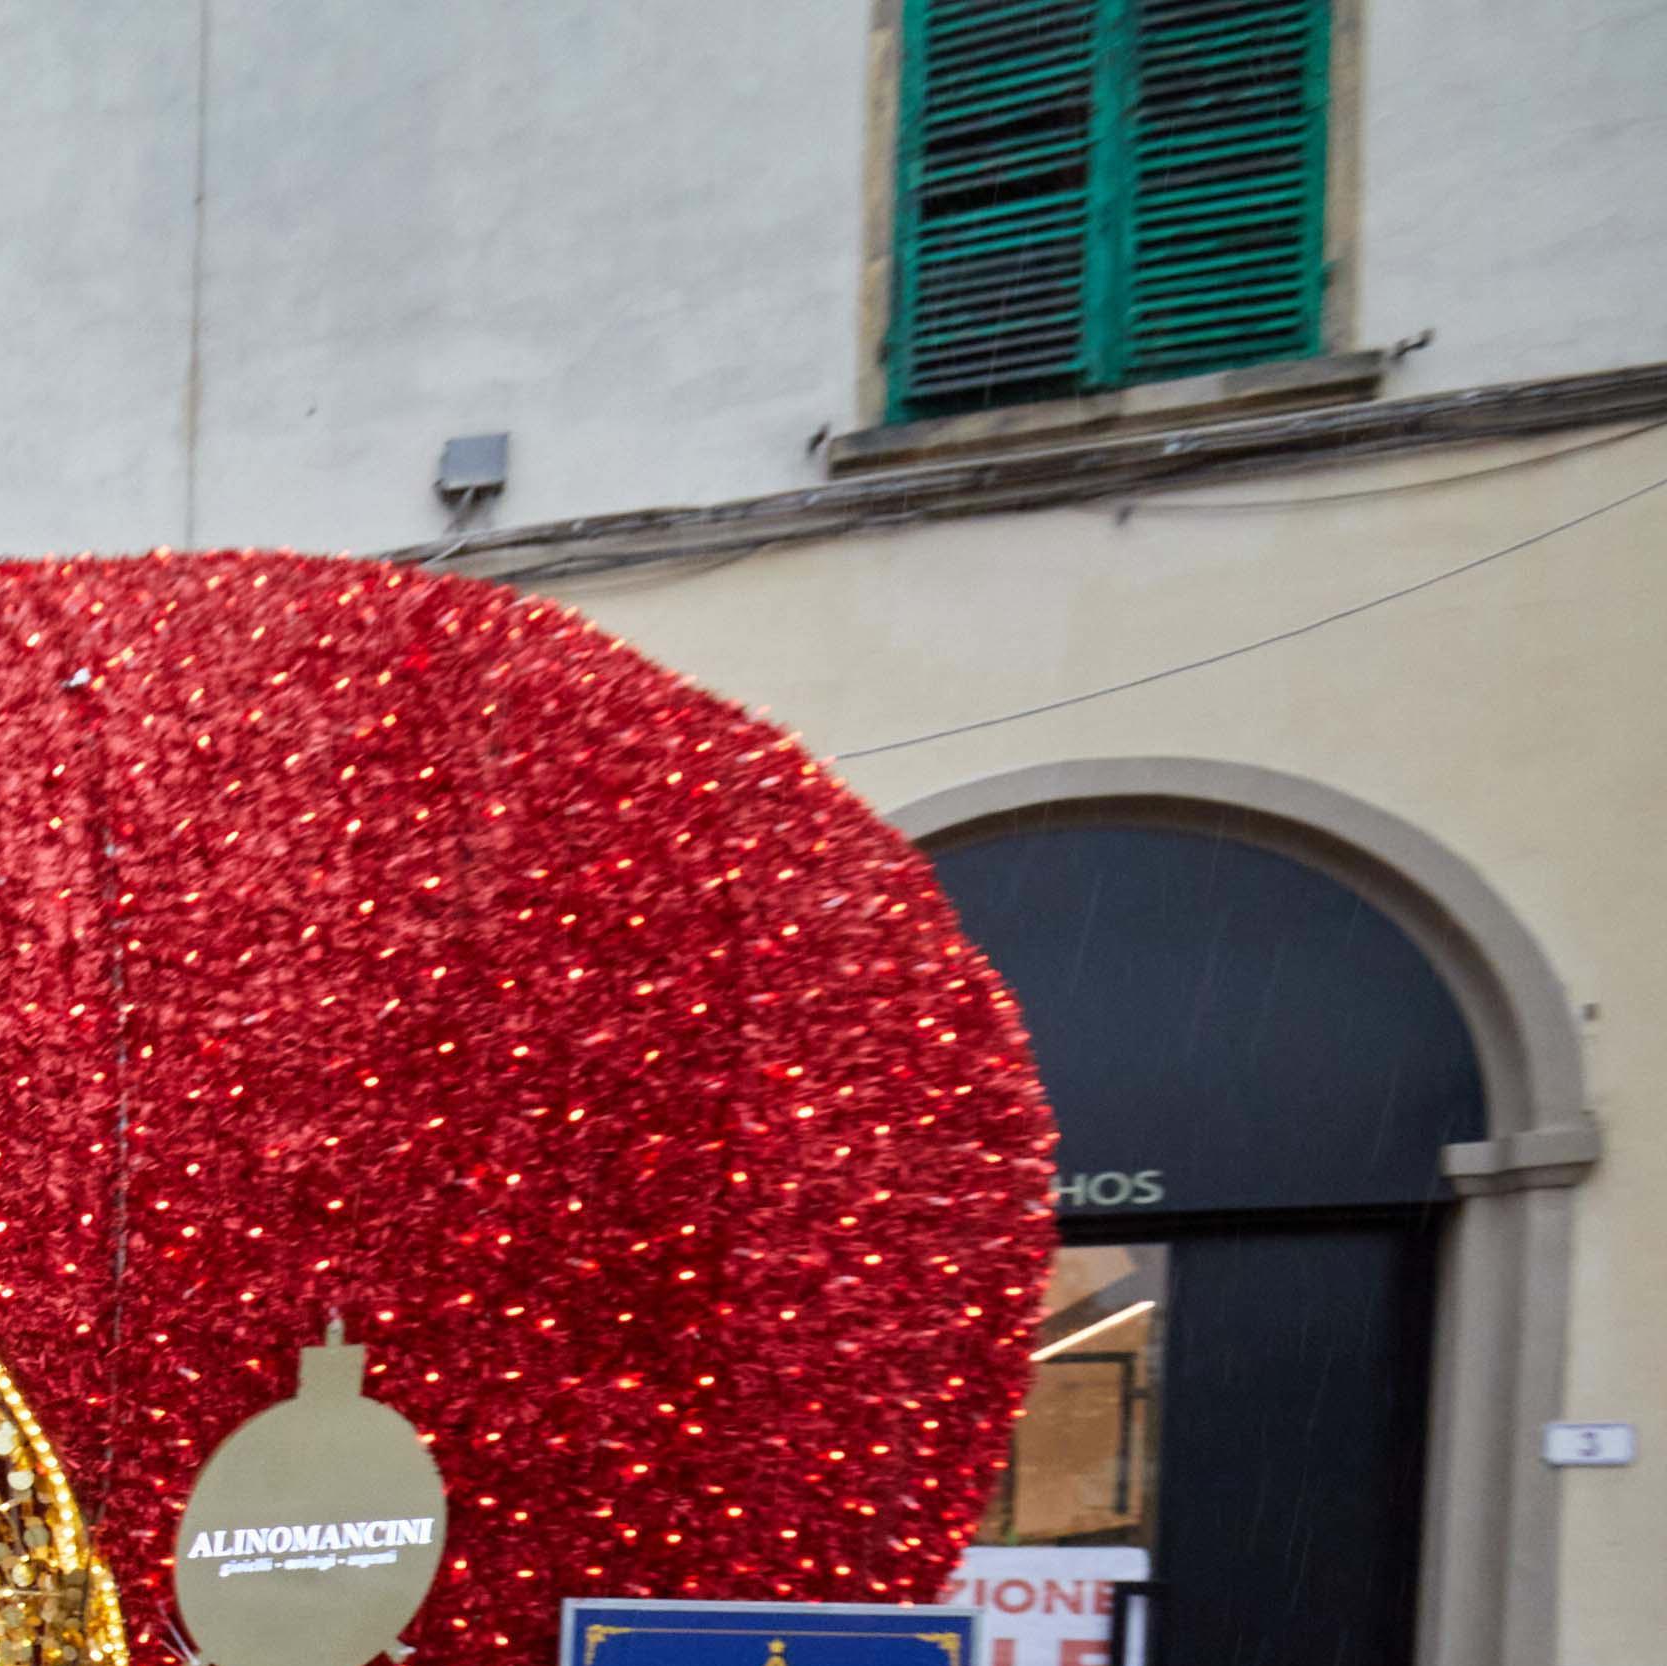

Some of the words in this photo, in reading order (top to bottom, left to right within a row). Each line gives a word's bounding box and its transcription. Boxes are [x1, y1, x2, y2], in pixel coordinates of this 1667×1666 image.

[1050, 1170, 1165, 1206] HOS
[187, 1518, 435, 1558] ALINOMANCINI
[936, 1578, 1116, 1615] ZIONE
